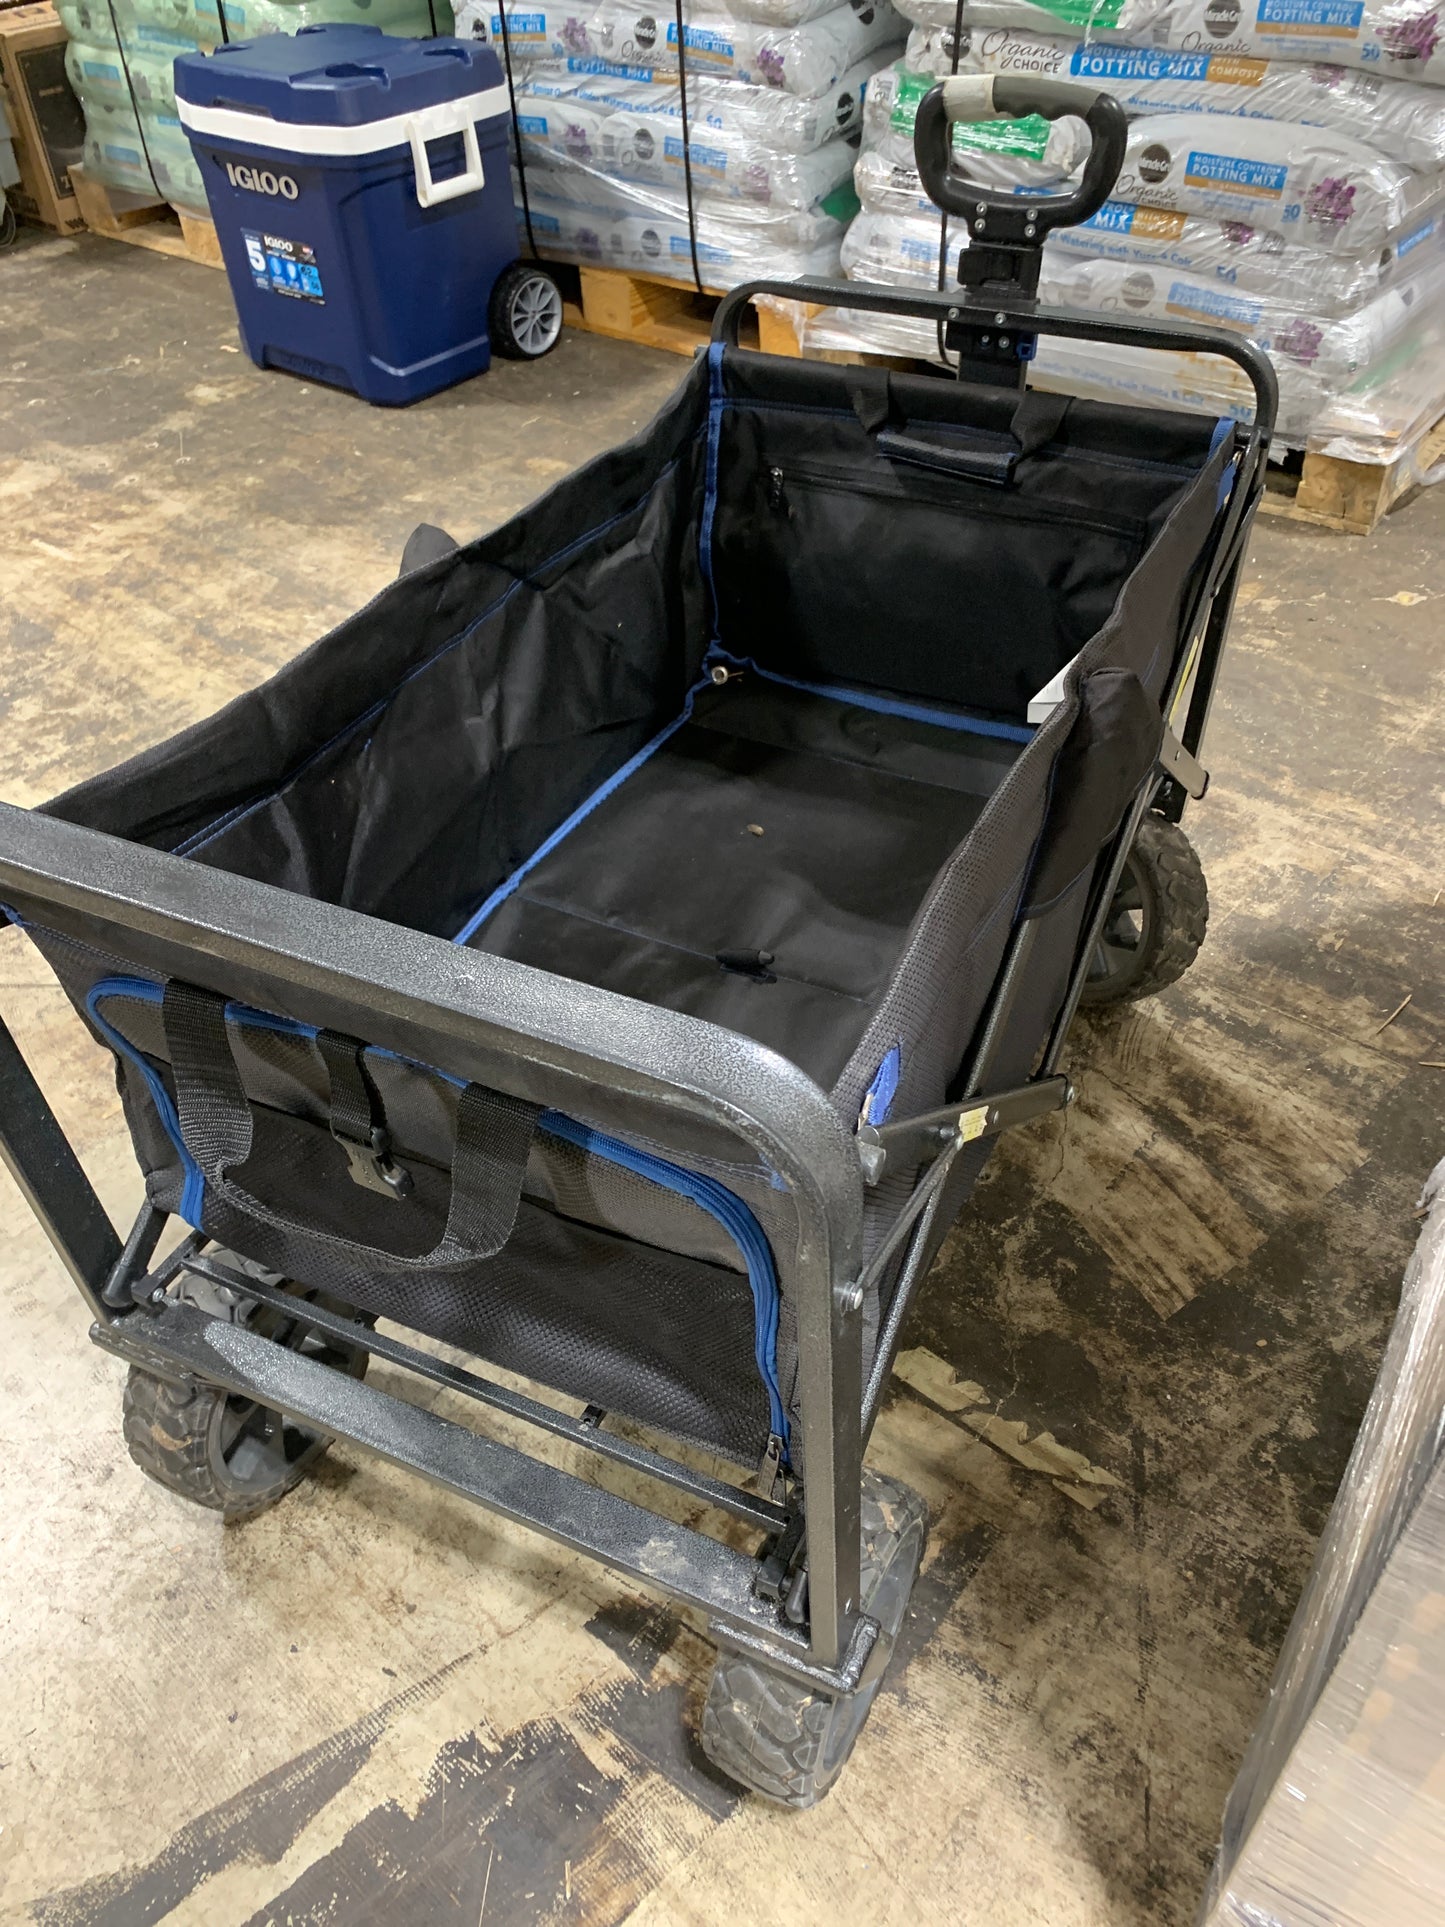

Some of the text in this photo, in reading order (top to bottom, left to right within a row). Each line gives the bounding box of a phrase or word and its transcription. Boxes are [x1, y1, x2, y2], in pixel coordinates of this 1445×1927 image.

[1264, 8, 1354, 25] POTTING MIX
[981, 28, 1066, 69] Organic
[1181, 31, 1251, 53] Organic
[1360, 42, 1381, 61] 50
[1013, 58, 1062, 74] CHOICE
[1080, 57, 1204, 76] POTTING MIX
[1209, 65, 1259, 79] COMPOST
[1194, 154, 1236, 169] MOISTURE
[226, 162, 299, 200] IGLOO
[1192, 163, 1248, 183] POTTING
[1251, 172, 1279, 188] MIX
[1115, 174, 1178, 203] Organic
[1093, 211, 1128, 231] MIX
[1281, 203, 1302, 224] 50
[264, 235, 293, 252] IGLOO
[1061, 233, 1105, 255] Watering
[245, 238, 266, 272] 5
